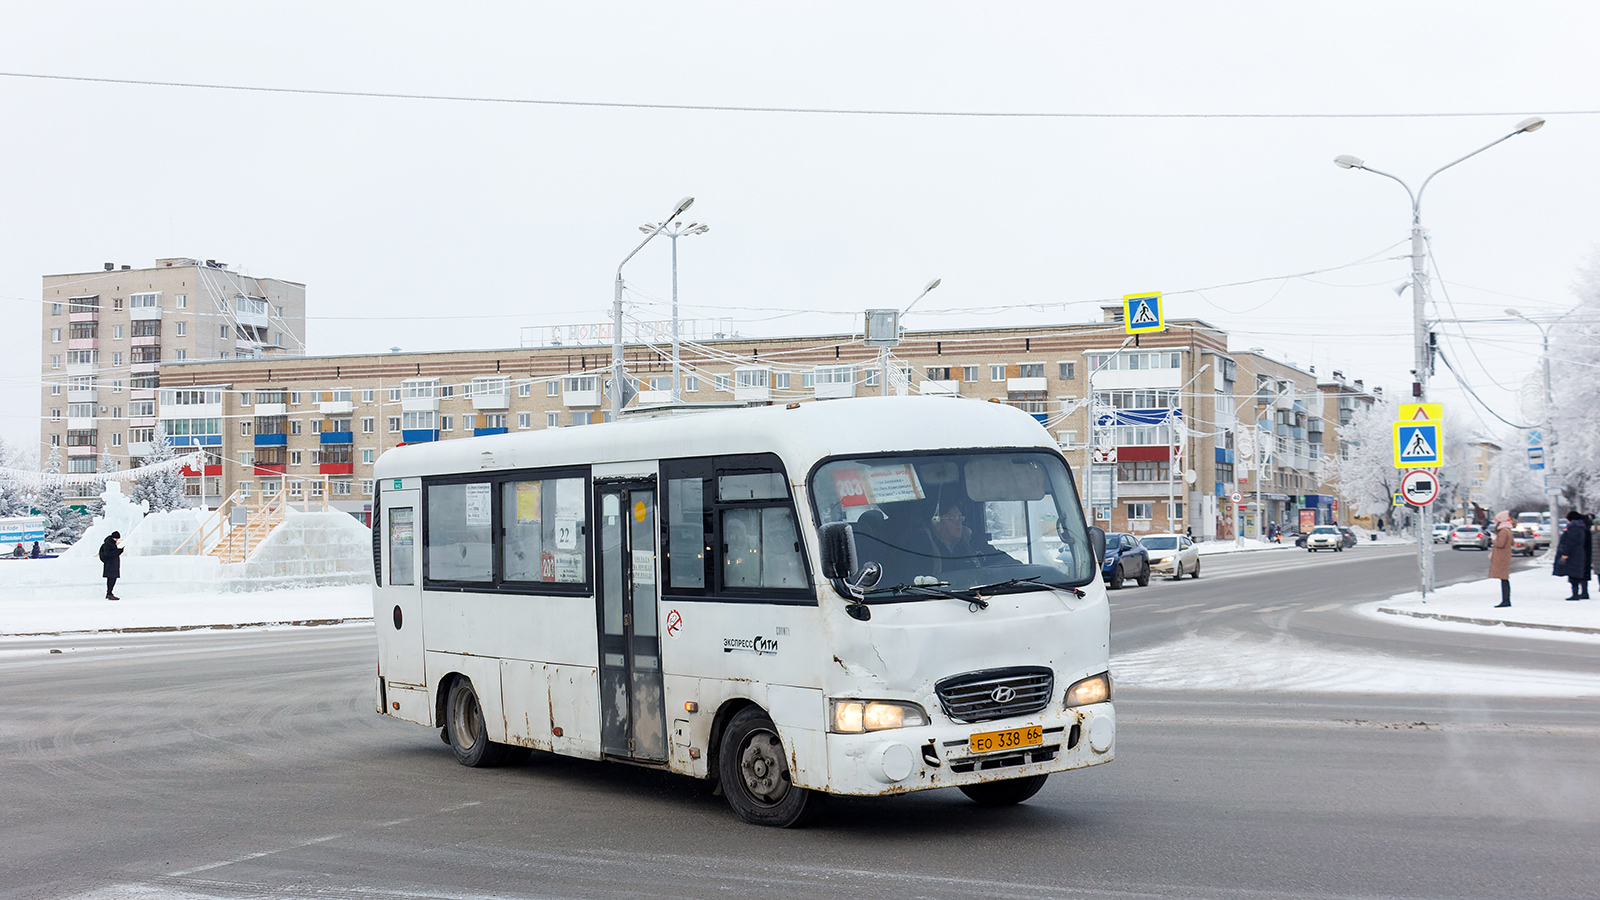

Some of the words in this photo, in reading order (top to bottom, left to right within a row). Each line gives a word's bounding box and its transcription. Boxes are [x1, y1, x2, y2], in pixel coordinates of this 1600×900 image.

[836, 479, 864, 498] 203
[559, 528, 569, 543] 22
[724, 638, 753, 648] ЭКСПРЕСС
[978, 738, 992, 750] ЕО
[998, 732, 1020, 748] 338
[1027, 728, 1039, 740] 66
